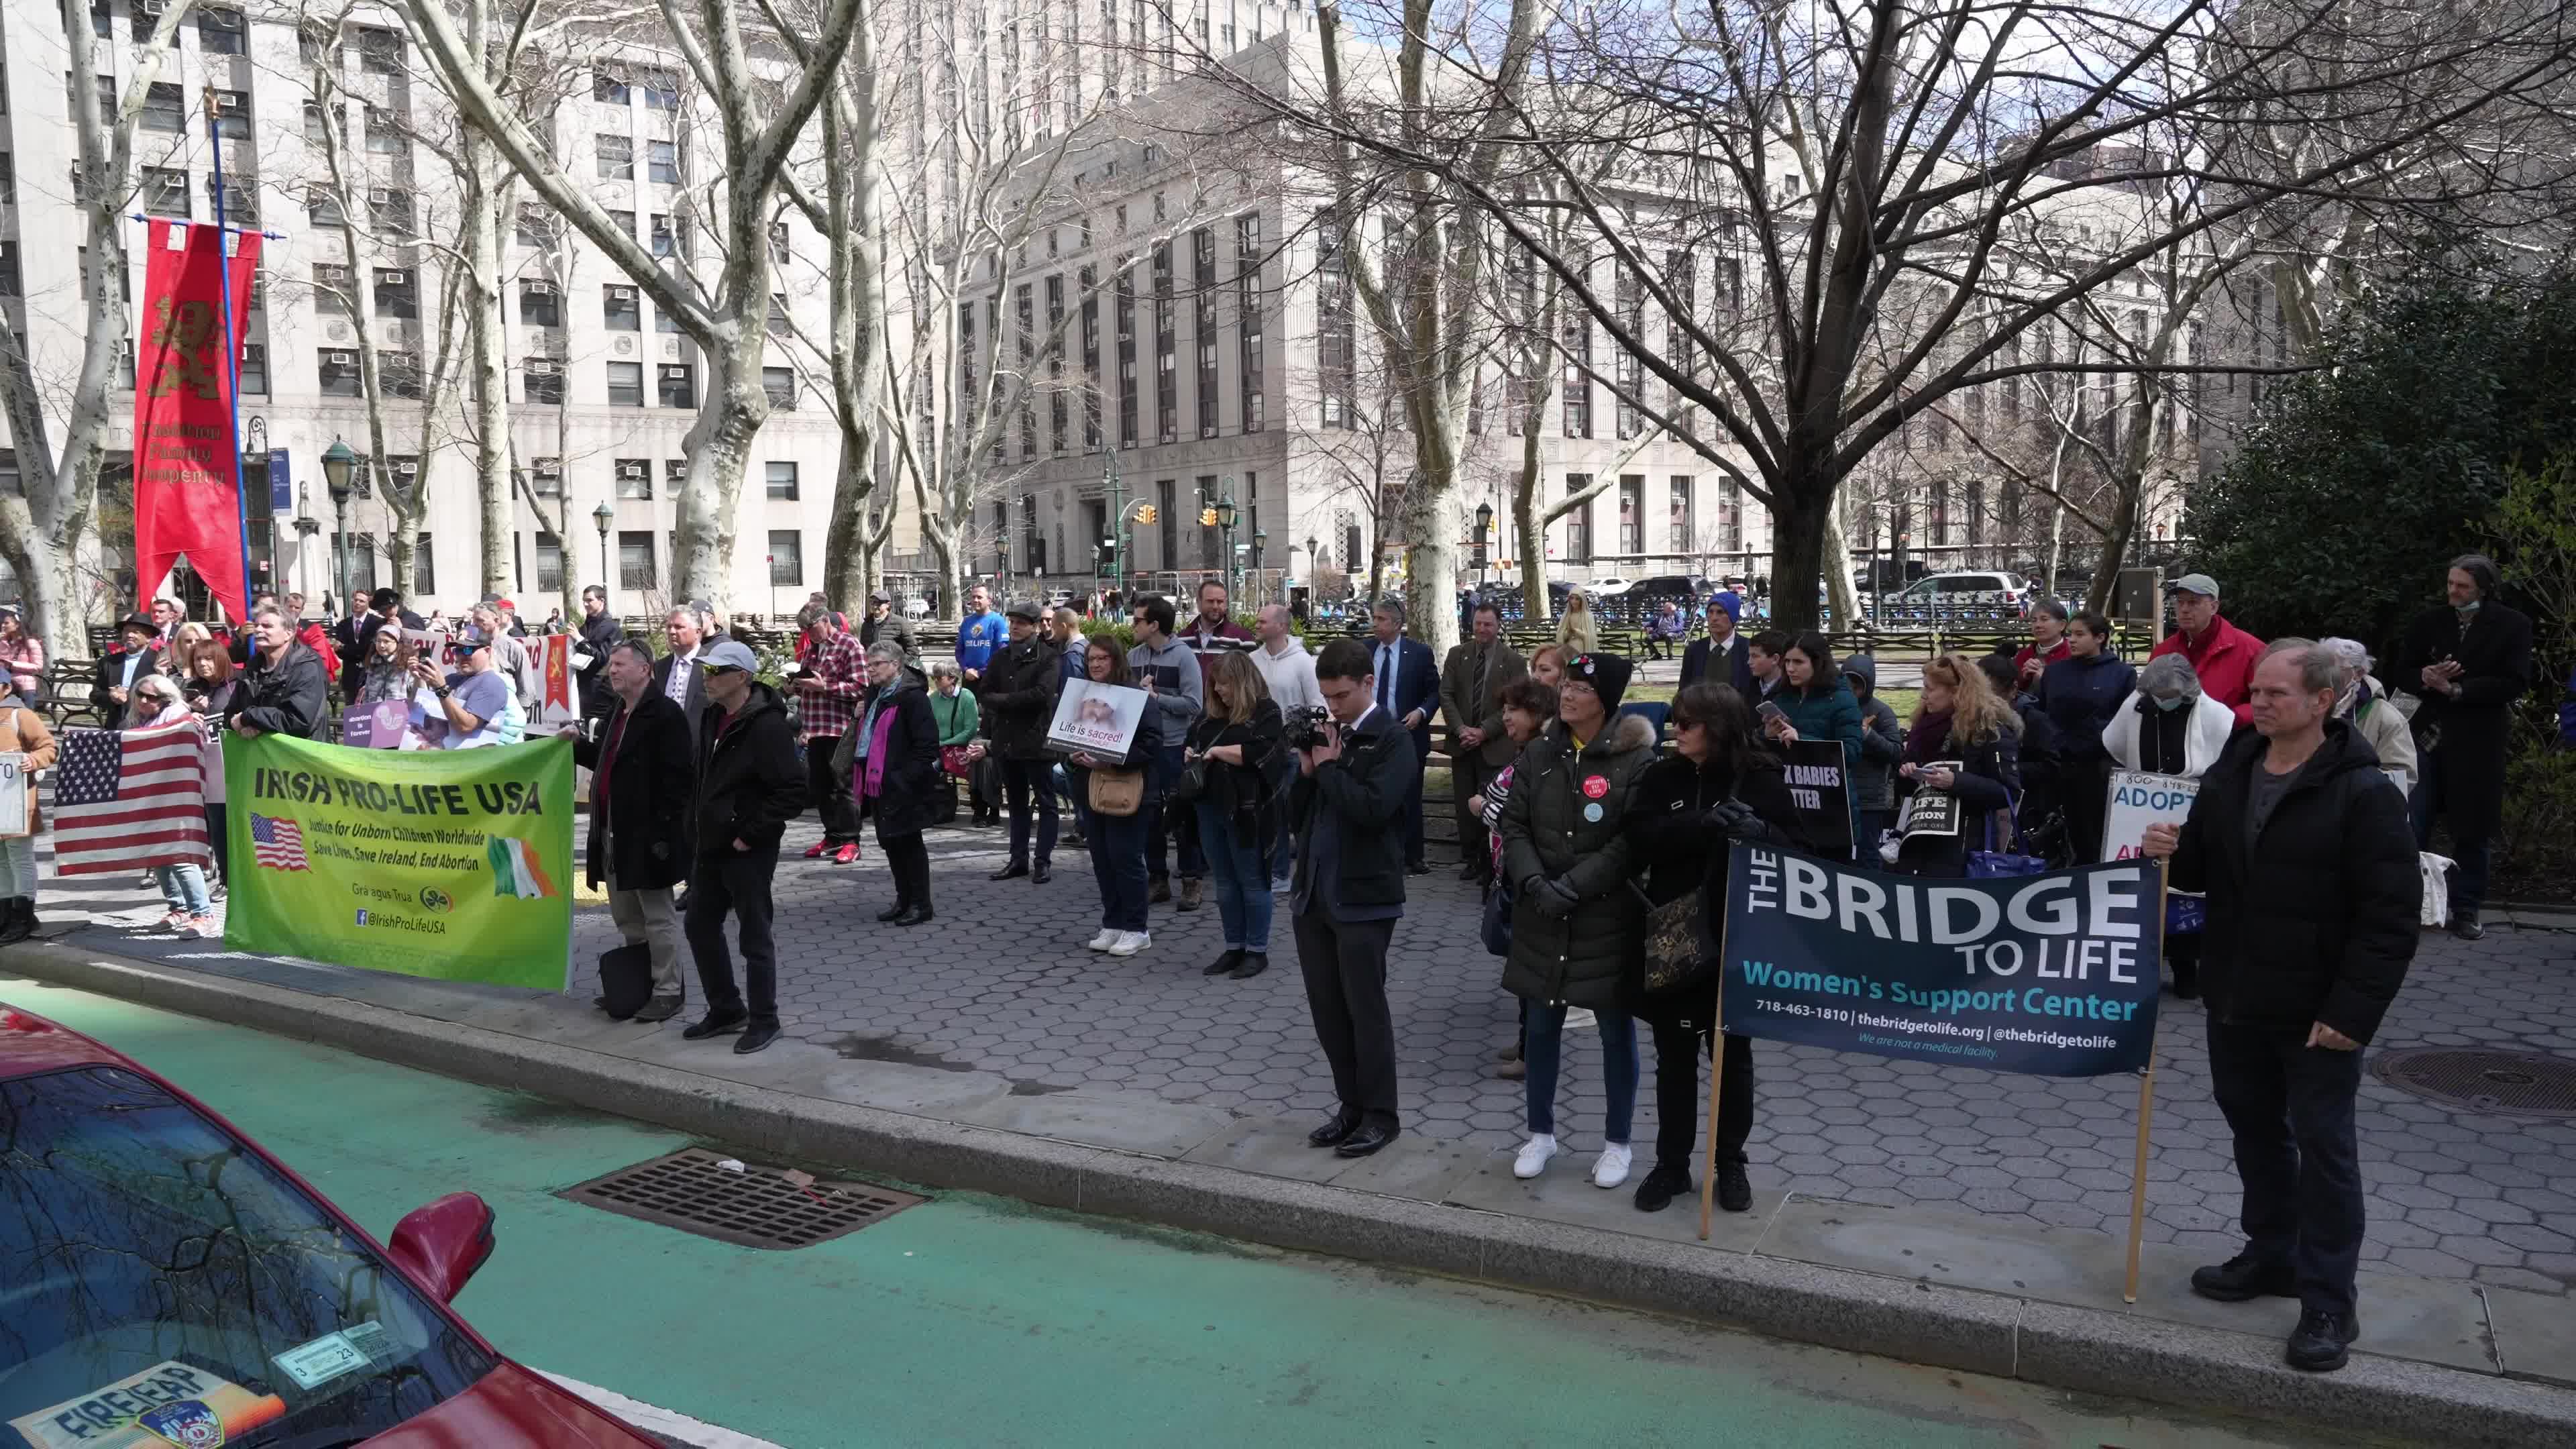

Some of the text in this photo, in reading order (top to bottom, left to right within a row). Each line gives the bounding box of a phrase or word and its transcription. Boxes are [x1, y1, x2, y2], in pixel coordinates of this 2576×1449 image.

[1059, 721, 1076, 733] Life
[1077, 724, 1085, 735] is
[1087, 729, 1123, 743] sacred!
[1794, 765, 1840, 788] BABIES
[254, 767, 542, 816] IRISH PRO-LIFE USA
[309, 818, 484, 845] Justice for Unborn Children Worldwide
[314, 839, 332, 855] Save
[354, 846, 377, 862] Save
[378, 849, 417, 869] Ireland,
[419, 853, 439, 867] End
[439, 853, 479, 871] Abortion
[1748, 848, 1777, 913] THE
[371, 889, 392, 901] agus
[392, 889, 413, 902] Trua
[1784, 856, 2141, 945] BRIDGE
[368, 912, 446, 934] @IrishProLifeUSA
[1953, 938, 2137, 983] TO LIFE
[1743, 960, 2138, 1021] Women's Support Center
[1756, 1000, 1848, 1022] 718-463-1810
[1858, 1013, 1984, 1040] thebridgetolife.org
[1994, 1028, 2116, 1049] @thebridgetolife
[1859, 1032, 1874, 1044] We
[1877, 1036, 1894, 1046] are
[1894, 1038, 1912, 1049] not
[1921, 1042, 1963, 1055] medical
[1964, 1044, 1998, 1061] facility.
[337, 1348, 354, 1360] 23
[295, 1366, 307, 1376] 3
